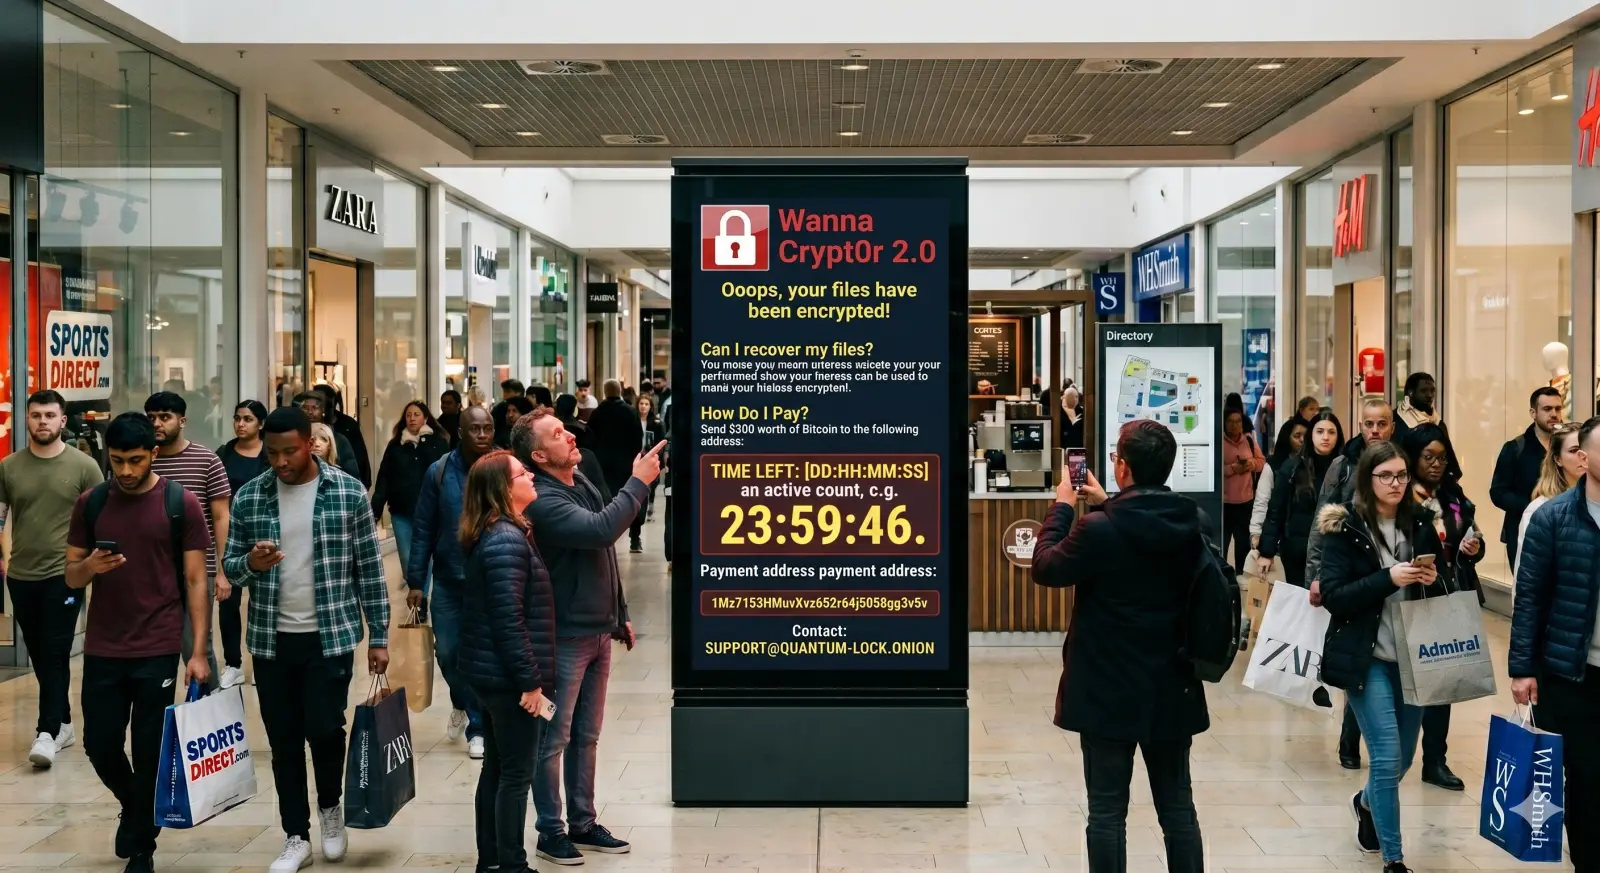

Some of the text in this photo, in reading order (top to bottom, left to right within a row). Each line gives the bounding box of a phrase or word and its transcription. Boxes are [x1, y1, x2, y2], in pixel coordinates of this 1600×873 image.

[326, 184, 379, 235] ZARA
[778, 208, 874, 232] Wanna
[1334, 173, 1367, 257] H&M
[892, 239, 936, 263] 2.0
[1137, 242, 1180, 293] WHSmith
[721, 280, 918, 301] Ooops, your files have
[1100, 284, 1118, 310] S
[748, 302, 890, 322] been encrypted!
[50, 322, 109, 357] SPORTS
[1106, 330, 1153, 343] Directory
[700, 341, 874, 360] Can I recover my files?
[700, 359, 720, 370] You
[893, 361, 917, 372] your
[918, 361, 942, 372] your
[759, 370, 788, 381] show
[789, 372, 813, 383] your
[854, 373, 873, 381] can
[875, 371, 889, 381] be
[890, 371, 916, 381] used
[917, 372, 929, 381] to
[731, 384, 755, 395] your
[701, 405, 809, 424] How Do I Pay?
[700, 422, 919, 436] Send $300 worth of Bitcoin to the following
[700, 435, 744, 446] address:
[710, 461, 929, 482] TIME LEFT: [DD:HH:MM:SS]
[740, 485, 760, 497] an
[763, 482, 812, 497] active
[815, 483, 864, 500] count,
[720, 504, 926, 545] 23:59:46.
[700, 563, 937, 580] Payment address payment address:
[792, 624, 847, 637] Contact:
[705, 641, 935, 658] SUPPORT@QUANTUM-LOCK.ONION
[1419, 634, 1480, 659] Admiral
[1259, 638, 1323, 684] ZAR
[186, 721, 245, 761] SPORTS
[1531, 747, 1553, 849] WHSmith
